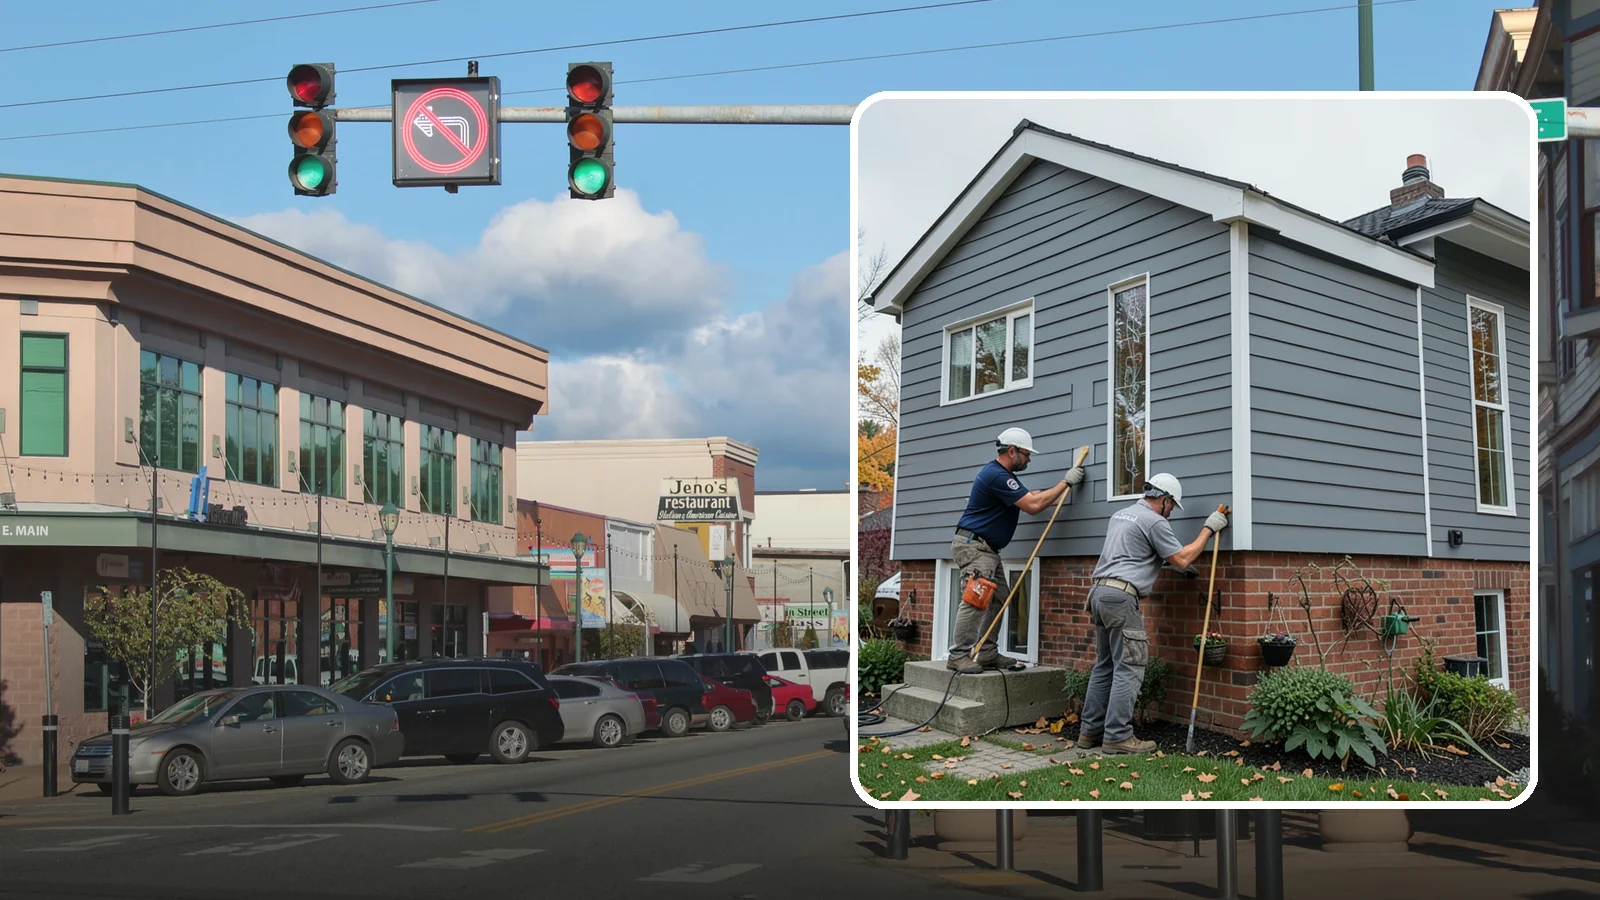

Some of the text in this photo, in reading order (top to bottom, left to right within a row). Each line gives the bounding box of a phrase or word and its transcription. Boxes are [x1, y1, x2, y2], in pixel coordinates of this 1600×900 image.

[670, 480, 727, 494] Jeno's
[665, 496, 731, 509] restaurant
[659, 510, 681, 519] Italian
[686, 510, 715, 519] American
[715, 509, 737, 519] Cuisine
[2, 525, 49, 536] E. MAIN
[797, 607, 828, 617] Street
